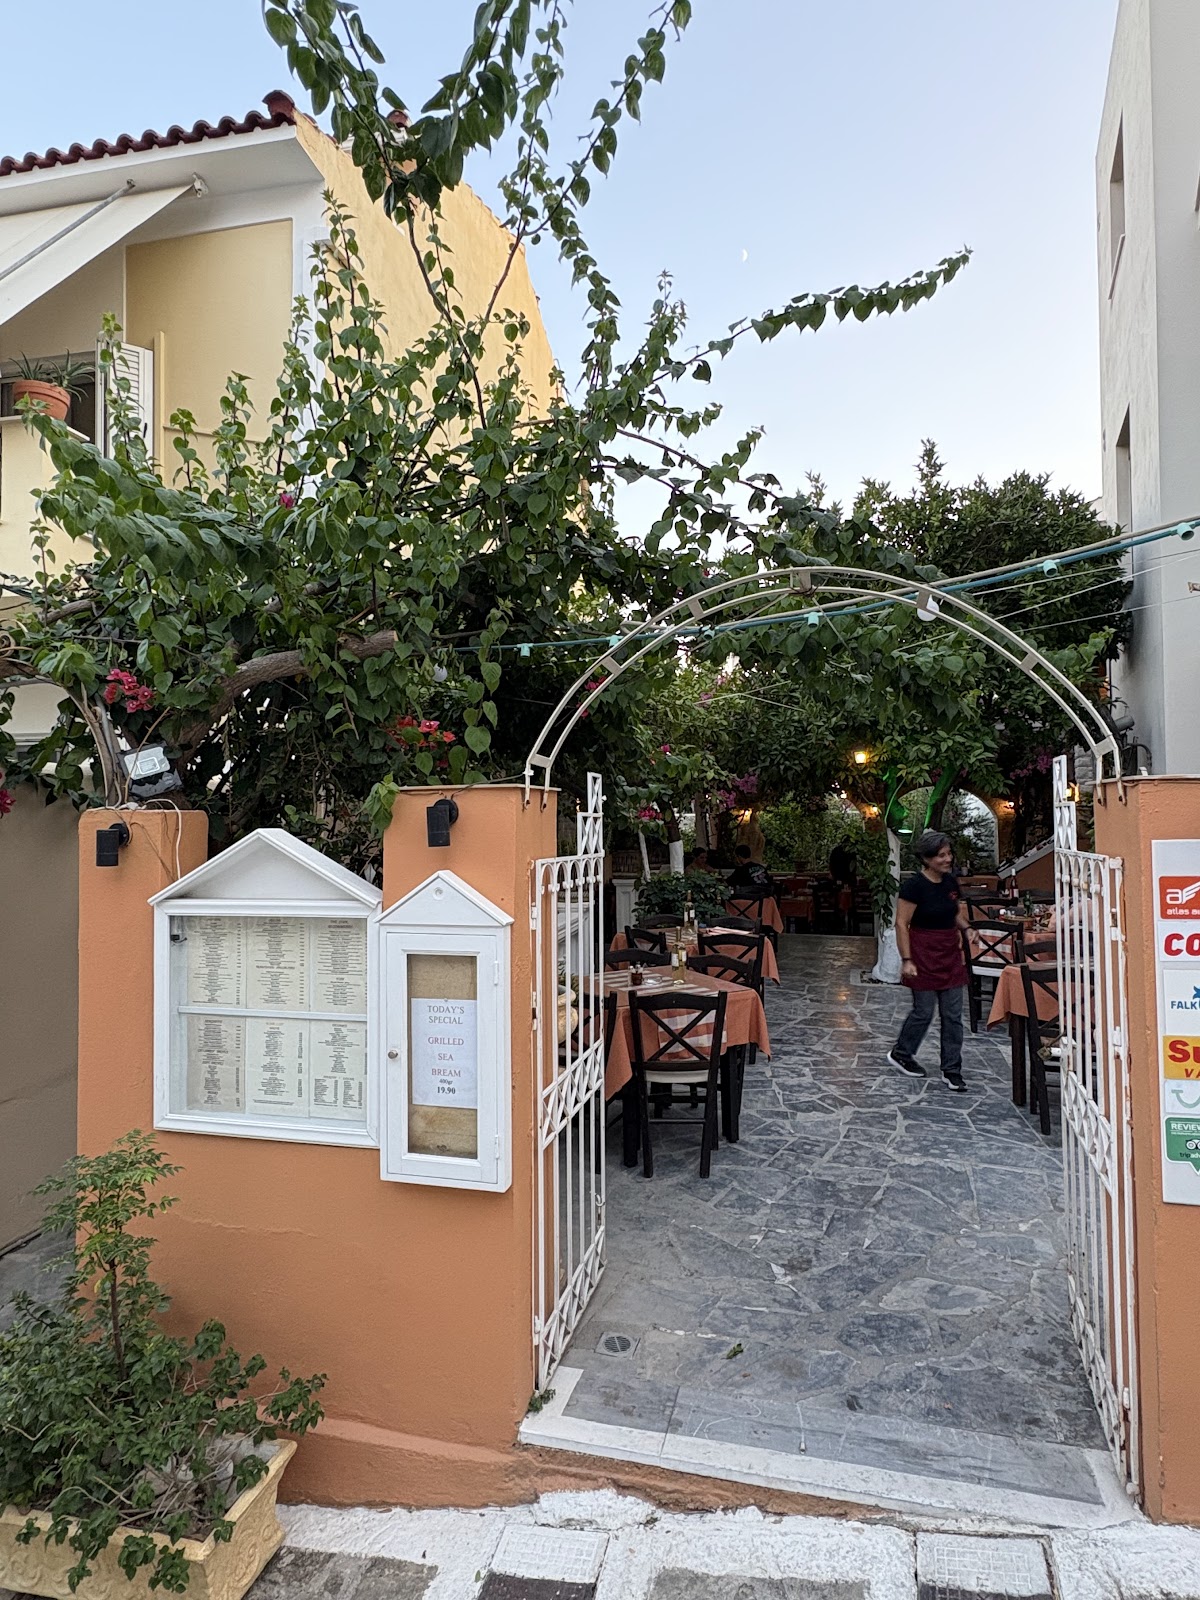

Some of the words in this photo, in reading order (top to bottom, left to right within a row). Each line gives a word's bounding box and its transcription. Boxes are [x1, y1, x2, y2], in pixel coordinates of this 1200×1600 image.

[1166, 907, 1190, 915] atlas
[1170, 1001, 1200, 1010] FALK
[428, 1015, 463, 1024] SPECIAL
[428, 1037, 464, 1045] GRILLED
[438, 1053, 454, 1061] SEA
[432, 1068, 461, 1077] BREAM
[437, 1086, 456, 1095] 19.90
